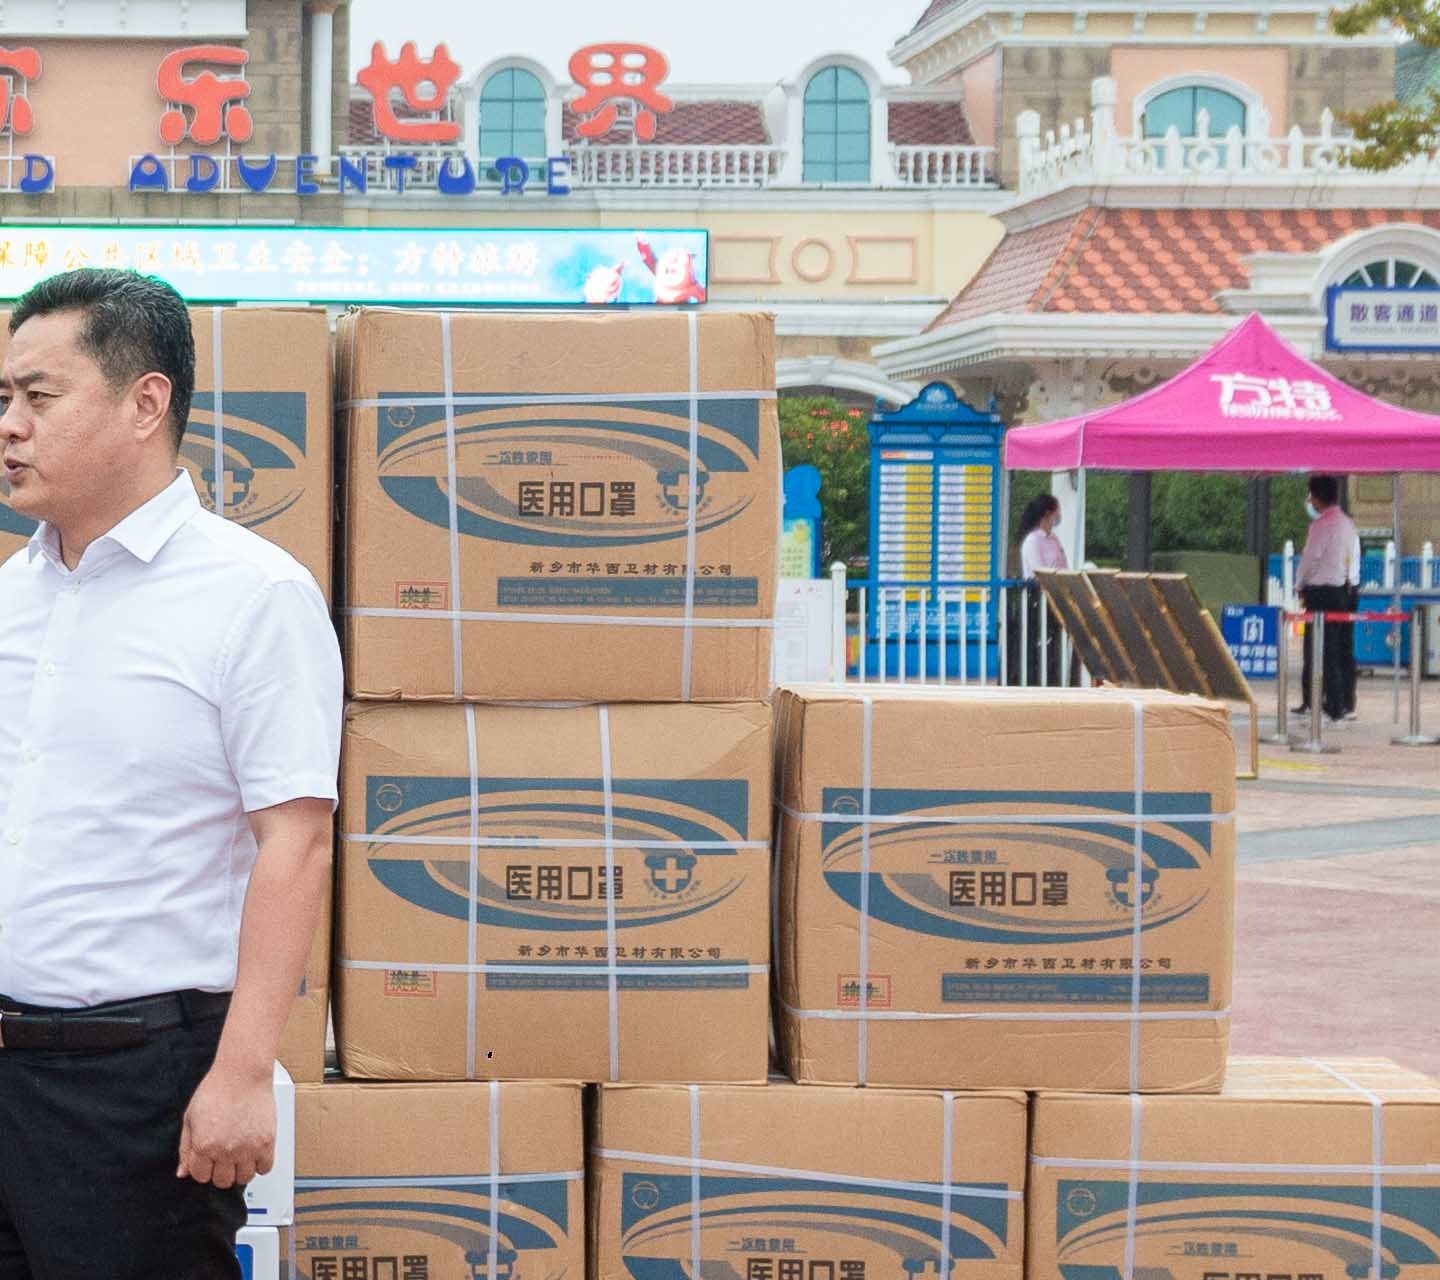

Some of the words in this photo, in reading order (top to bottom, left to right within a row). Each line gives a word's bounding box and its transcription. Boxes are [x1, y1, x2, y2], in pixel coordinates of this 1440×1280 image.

[128, 152, 575, 195] ADVENTURE
[1350, 302, 1439, 324] 散客通道
[1209, 372, 1333, 410] 方特
[518, 480, 636, 517] 医用口罩
[506, 864, 624, 901] 医用口罩
[949, 870, 1069, 907] 医用口罩
